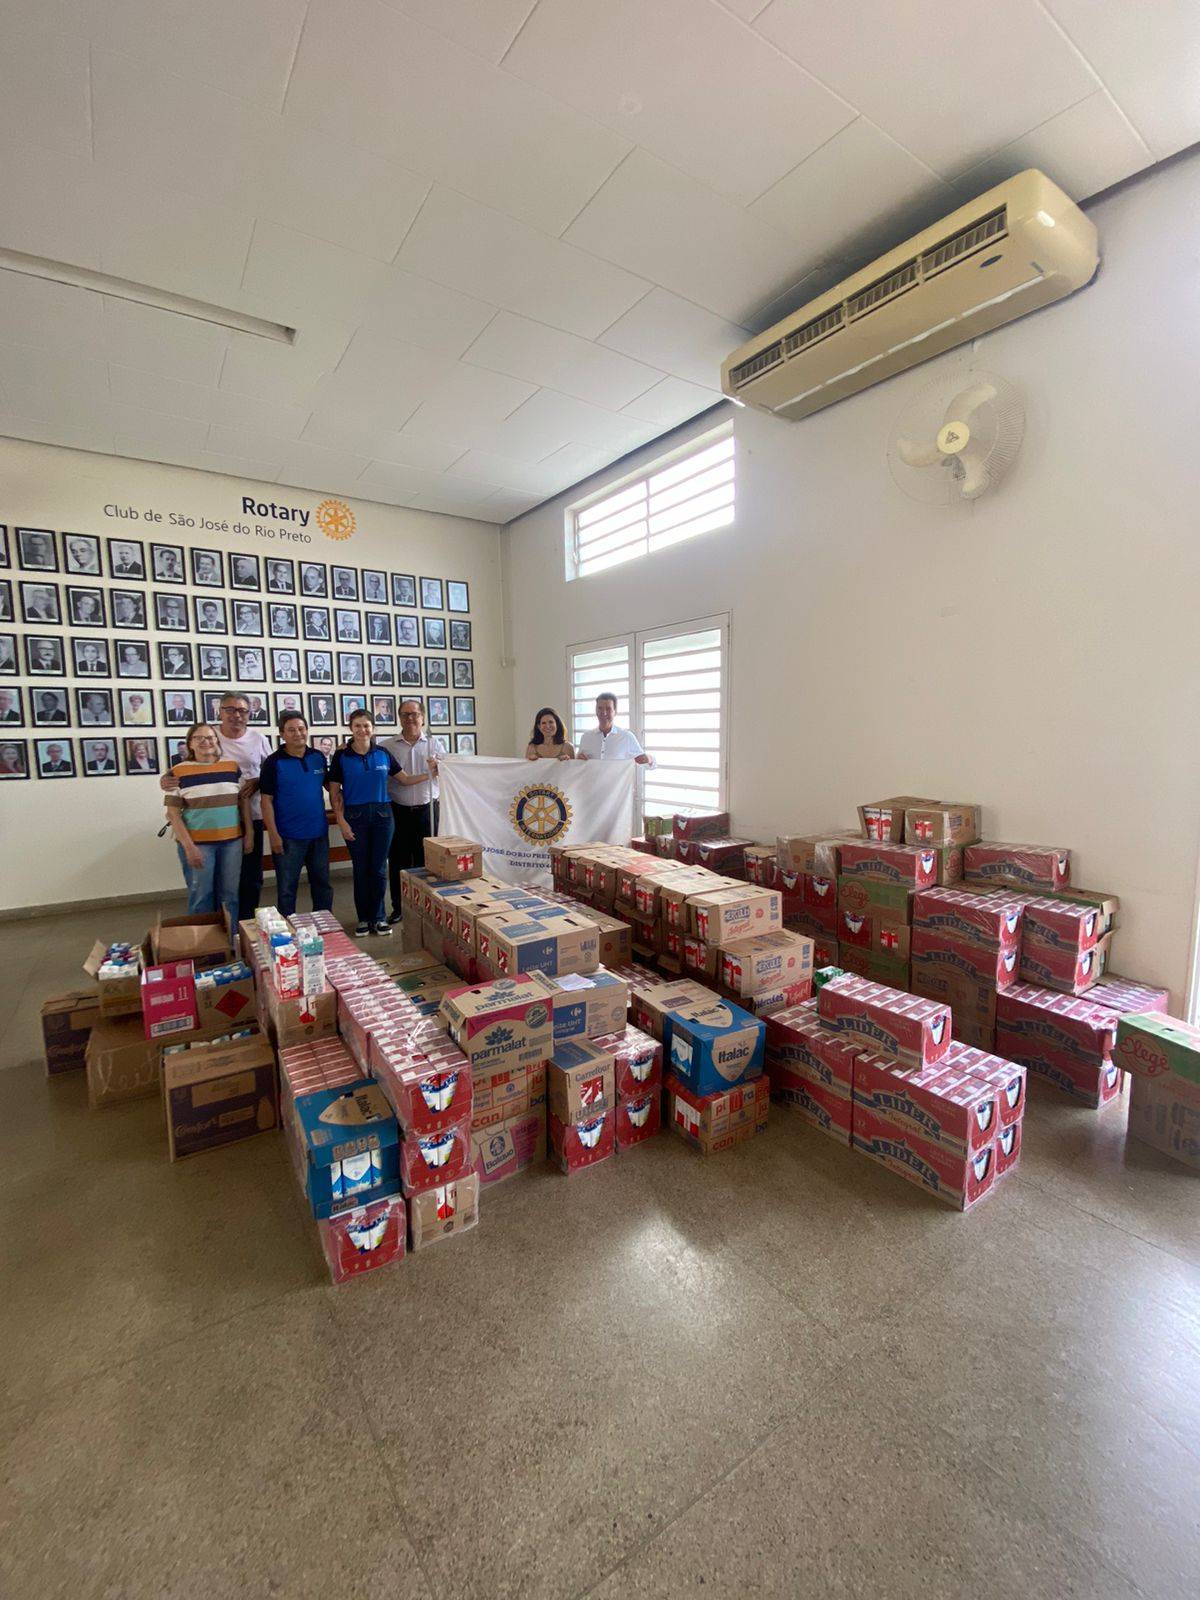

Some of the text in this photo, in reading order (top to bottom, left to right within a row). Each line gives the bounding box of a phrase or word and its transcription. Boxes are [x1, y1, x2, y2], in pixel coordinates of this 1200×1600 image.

[242, 496, 310, 527] Rotary
[103, 504, 312, 544] Club de São José do Rio Preto
[510, 860, 545, 869] DISTRITO
[540, 960, 553, 968] UHT
[475, 992, 534, 1011] parmalat
[690, 1005, 721, 1019] Italac
[471, 1036, 527, 1065] parmalat
[718, 1046, 750, 1064] Italac
[575, 1063, 611, 1082] Carrefour
[471, 1112, 500, 1128] can
[878, 1093, 942, 1134] LIDER
[712, 1135, 734, 1151] can
[877, 1140, 940, 1183] LIDER
